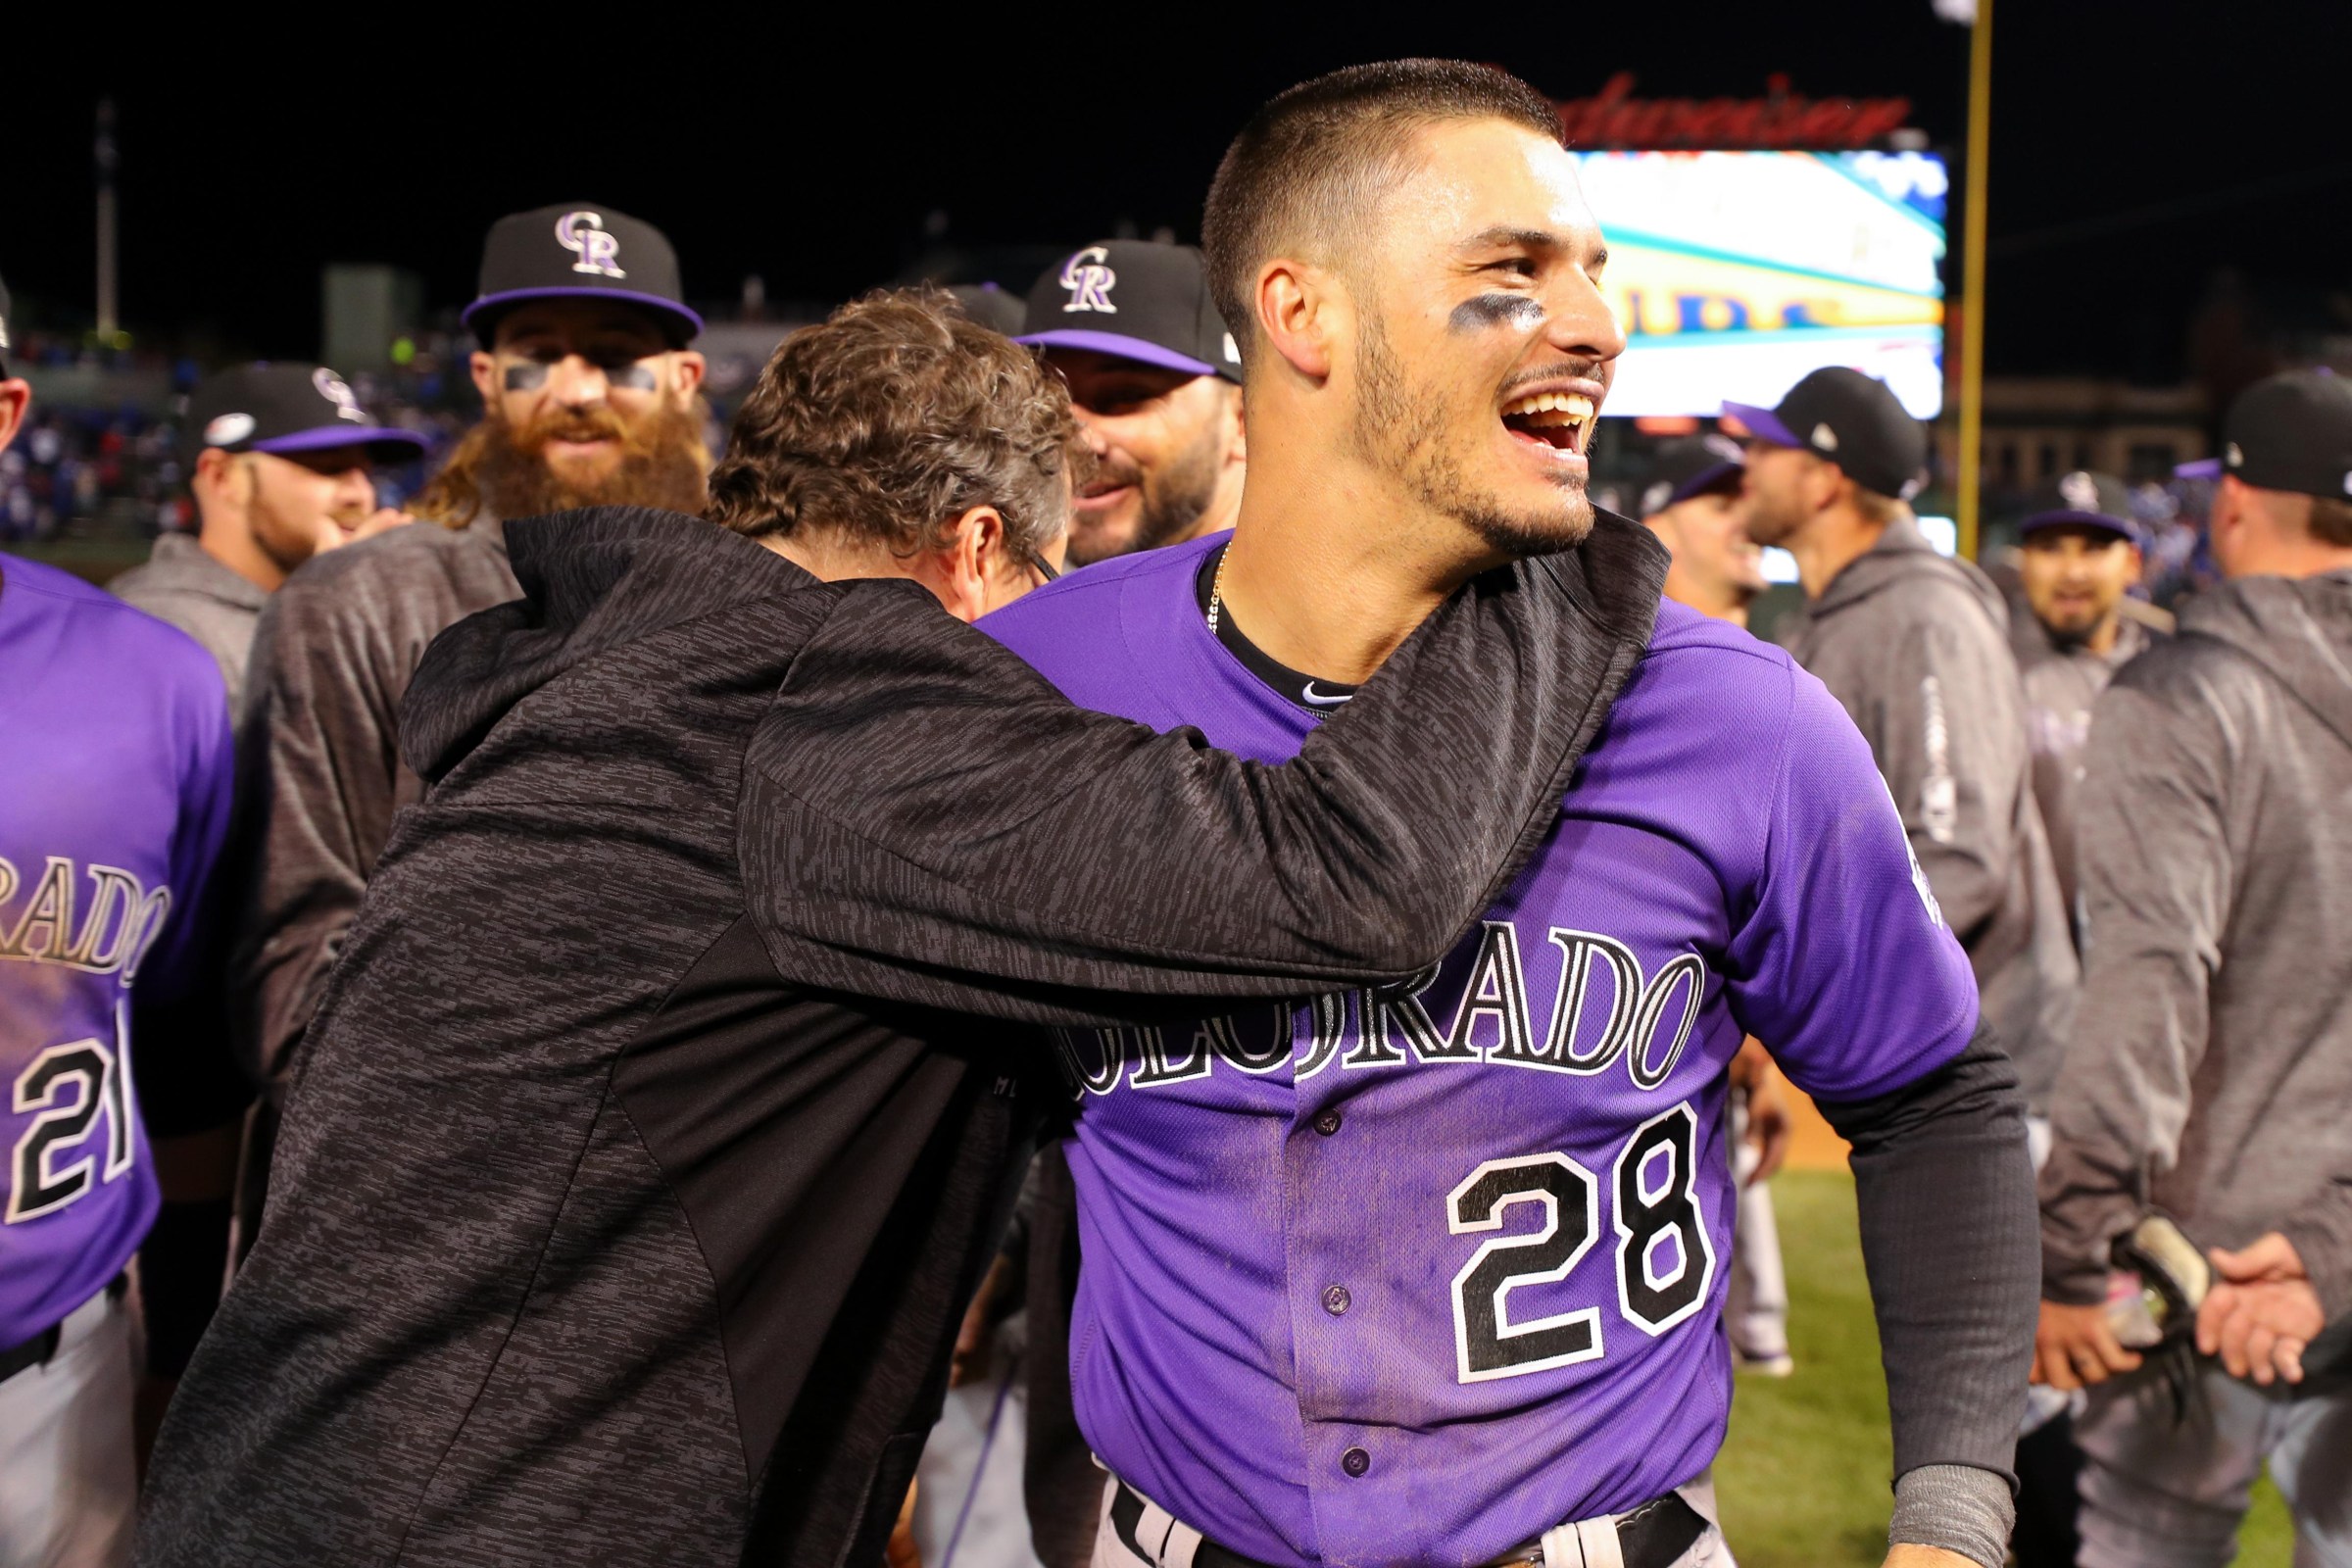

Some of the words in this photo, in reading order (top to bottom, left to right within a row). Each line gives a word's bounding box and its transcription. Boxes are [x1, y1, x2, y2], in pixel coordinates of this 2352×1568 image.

[554, 211, 627, 279] CR
[1058, 246, 1117, 314] CR
[1446, 1100, 1717, 1385] 28
